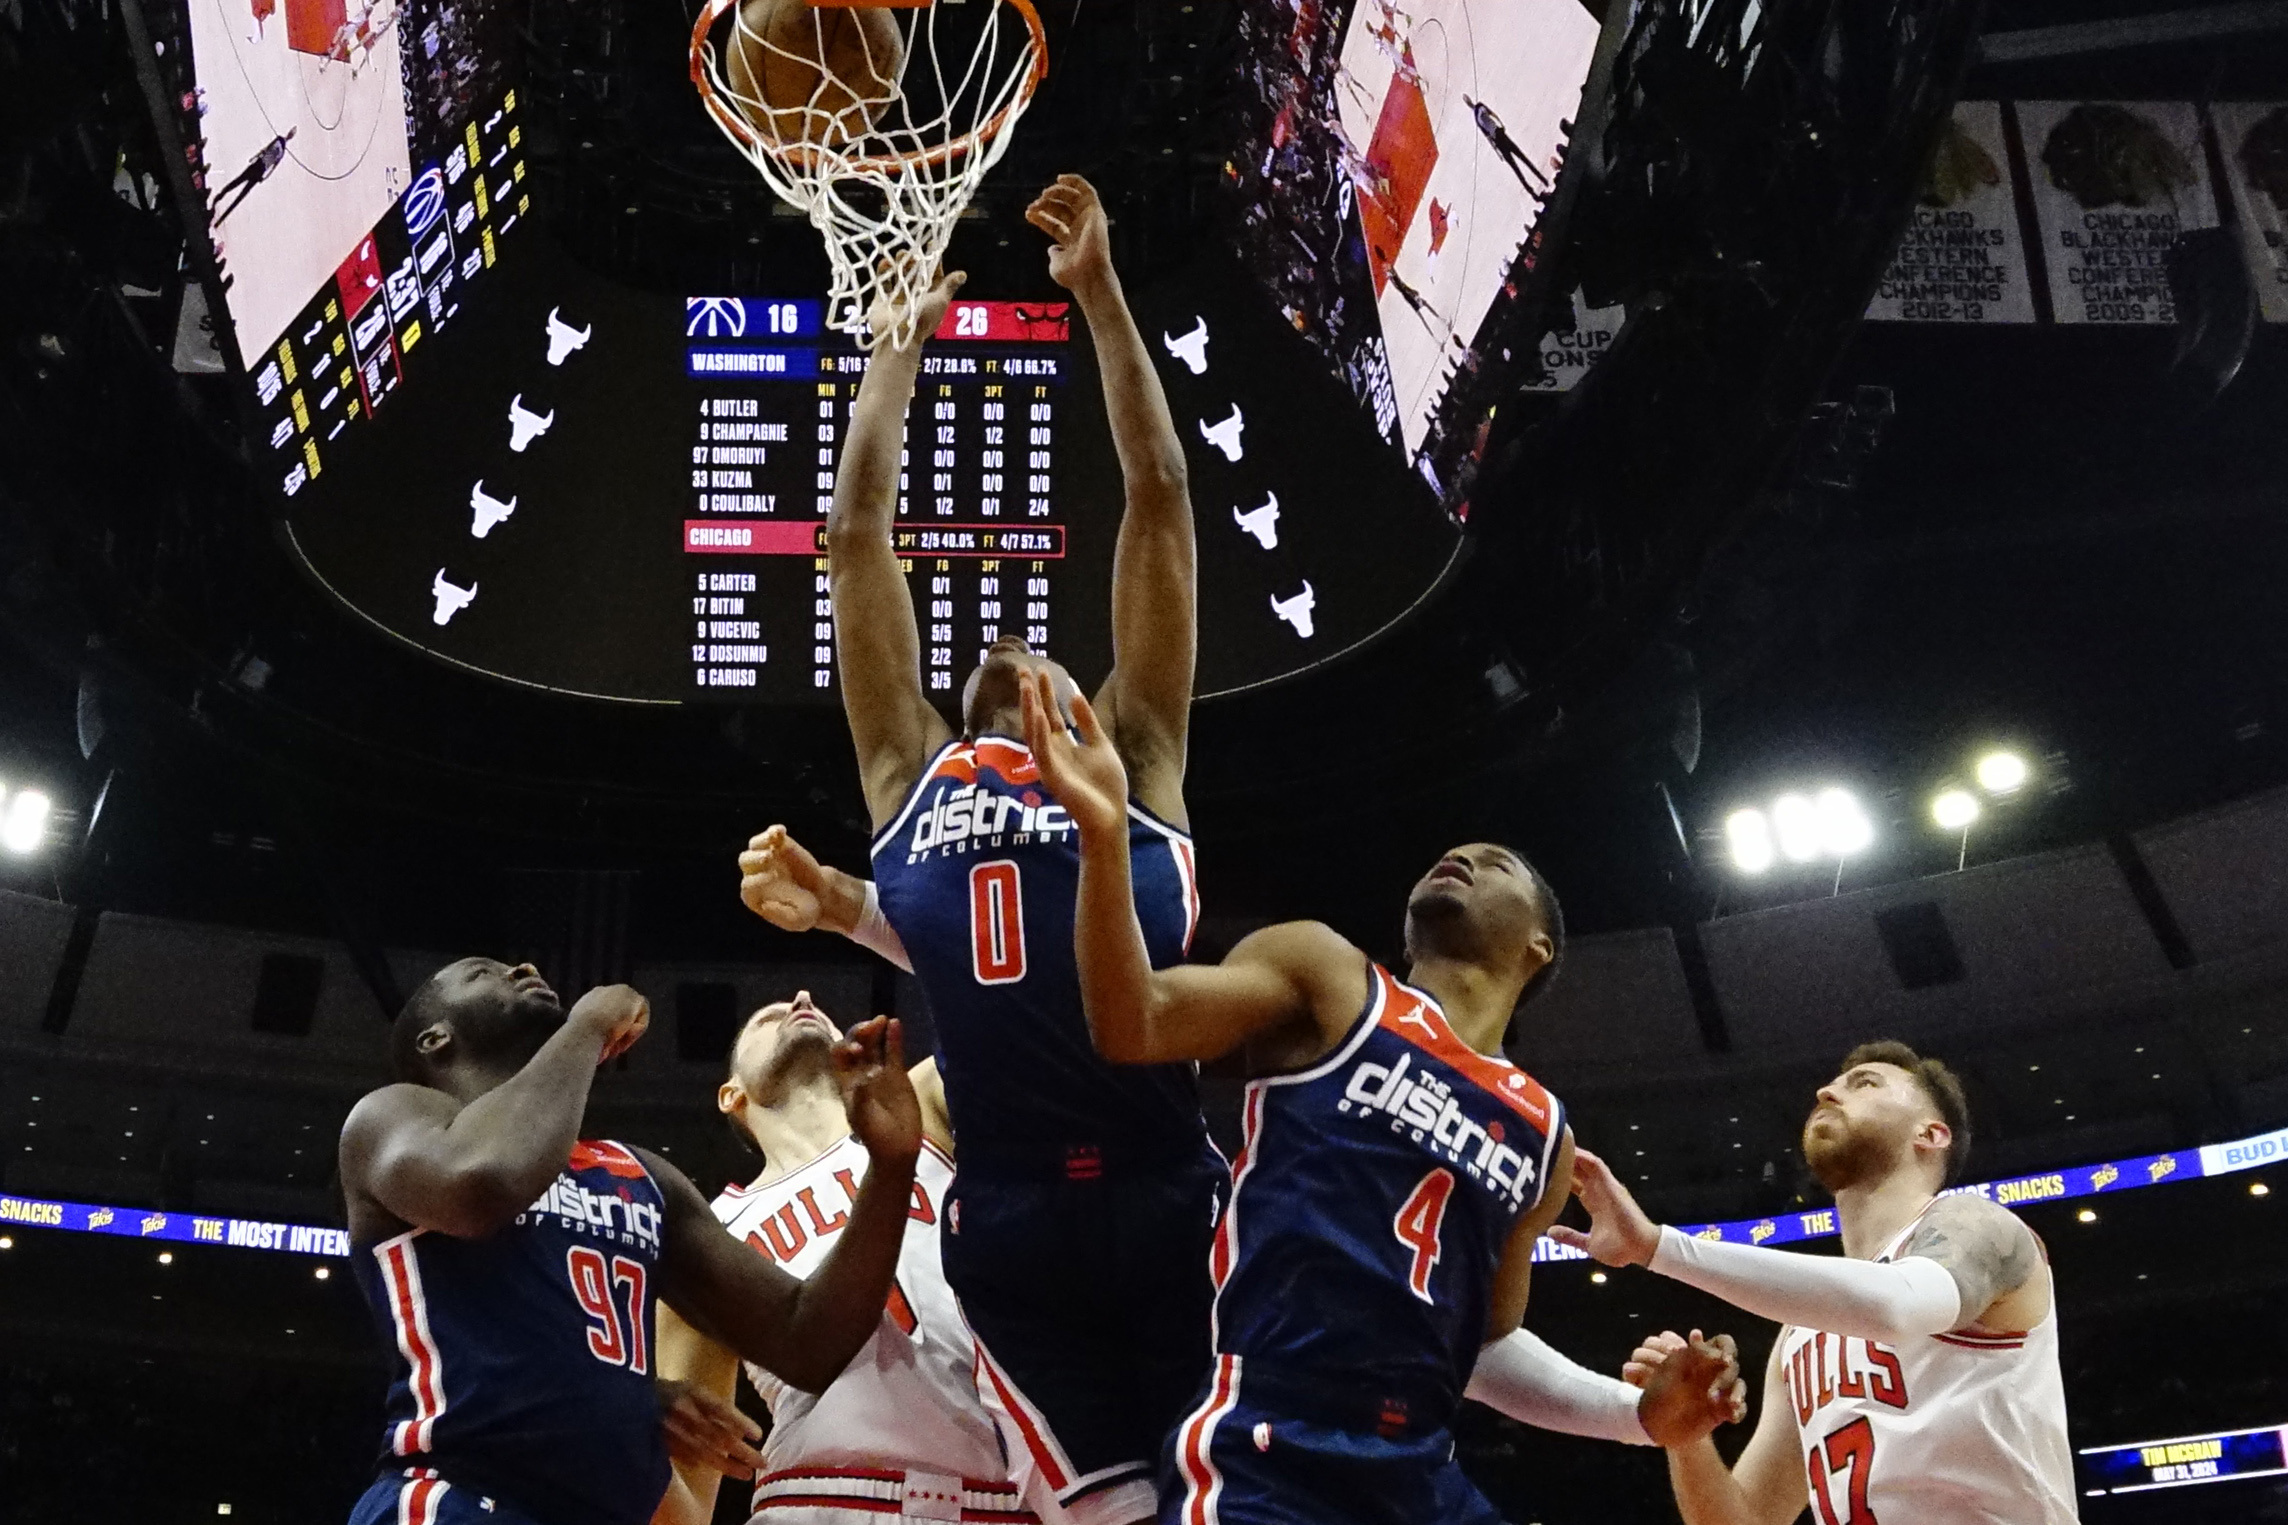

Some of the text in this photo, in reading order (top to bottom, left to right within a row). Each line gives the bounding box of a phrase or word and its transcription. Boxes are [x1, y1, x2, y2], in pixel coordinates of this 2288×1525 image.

[1912, 211, 1975, 229] ICAGO
[2084, 213, 2175, 230] CHICAGO
[1904, 229, 2004, 247] CKHAWKS
[2061, 230, 2178, 249] BLACKHAW
[420, 231, 448, 274] 16
[2081, 249, 2163, 267] WESTE
[2068, 267, 2168, 285] CONFERE
[386, 256, 420, 323] 2:37
[768, 303, 798, 334] 16
[955, 306, 989, 336] 26
[1902, 302, 1984, 320] 2012-13
[2085, 303, 2174, 321] 2009-2
[355, 304, 386, 351] 26
[1557, 330, 1611, 348] CUP
[691, 353, 786, 372] WASHINGTON
[838, 355, 862, 374] 5/16
[923, 357, 942, 375] 2/7
[943, 358, 977, 374] 28.6%
[1002, 358, 1023, 376] 4/6
[1024, 359, 1057, 375] 66.7%
[818, 384, 1047, 398] MIN FG 3PT FT
[699, 398, 1052, 422] 4 BUTLER 01 0/0 0/0 0/0
[700, 422, 1051, 446] 9 CHAMPAGNIE 03 1/2 1/2 0/0
[692, 446, 709, 464] 97
[712, 446, 766, 465] OMORUYI
[818, 447, 833, 466] 01
[934, 449, 955, 468] 0/0
[982, 449, 1004, 469] 0/0
[1029, 450, 1051, 470] 0/0
[692, 469, 709, 488] 33
[711, 470, 753, 489] KUZMA
[817, 471, 834, 490] 09
[933, 472, 952, 492] 0/1
[982, 473, 1003, 493] 0/0
[1029, 474, 1050, 493] 0/0
[699, 493, 708, 512] 0
[711, 493, 776, 513] COULIBALY
[935, 496, 954, 516] 1/2
[981, 497, 1000, 516] 0/1
[1028, 497, 1050, 517] 2/4
[688, 527, 753, 547] CHICAGO
[920, 531, 940, 550] 2/5
[941, 532, 975, 549] 40.0%
[1000, 533, 1019, 551] 4/7
[1020, 533, 1052, 550] 57.1%
[902, 561, 913, 573] EB
[937, 560, 949, 572] FG
[982, 561, 999, 573] 3PT
[1033, 562, 1043, 573] FT
[698, 573, 707, 591] 5
[710, 573, 756, 592] CARTER
[931, 576, 951, 595] 0/1
[980, 576, 999, 596] 0/1
[1027, 577, 1049, 597] 0/0
[692, 597, 1049, 620] 17 BITIM 03 0/0 0/0 0/0
[697, 620, 1048, 644] 9 VUCEVIC 09 5/5 1/1 3/3
[692, 644, 952, 666] 12 DOSUNMU 09 2/2
[696, 668, 952, 690] 6 CARUSO 07 3/5
[911, 785, 1079, 853] distric
[942, 830, 1068, 858] COLUMBI
[969, 859, 1027, 986] 0
[1420, 1069, 1451, 1100] THE
[1346, 1051, 1536, 1204] district
[2226, 1140, 2277, 1165] BUD
[1997, 1175, 2065, 1205] SNACKS
[0, 1197, 63, 1226] SNACKS
[193, 1218, 225, 1242] THE
[227, 1219, 288, 1250] MOST
[289, 1225, 350, 1257] INTEN
[1800, 1211, 1834, 1235] THE
[1395, 1167, 1454, 1305] 4
[567, 1245, 647, 1375] 97
[1784, 1331, 1909, 1428] ULLS
[2141, 1447, 2167, 1466] TIM
[1809, 1414, 1878, 1525] 17
